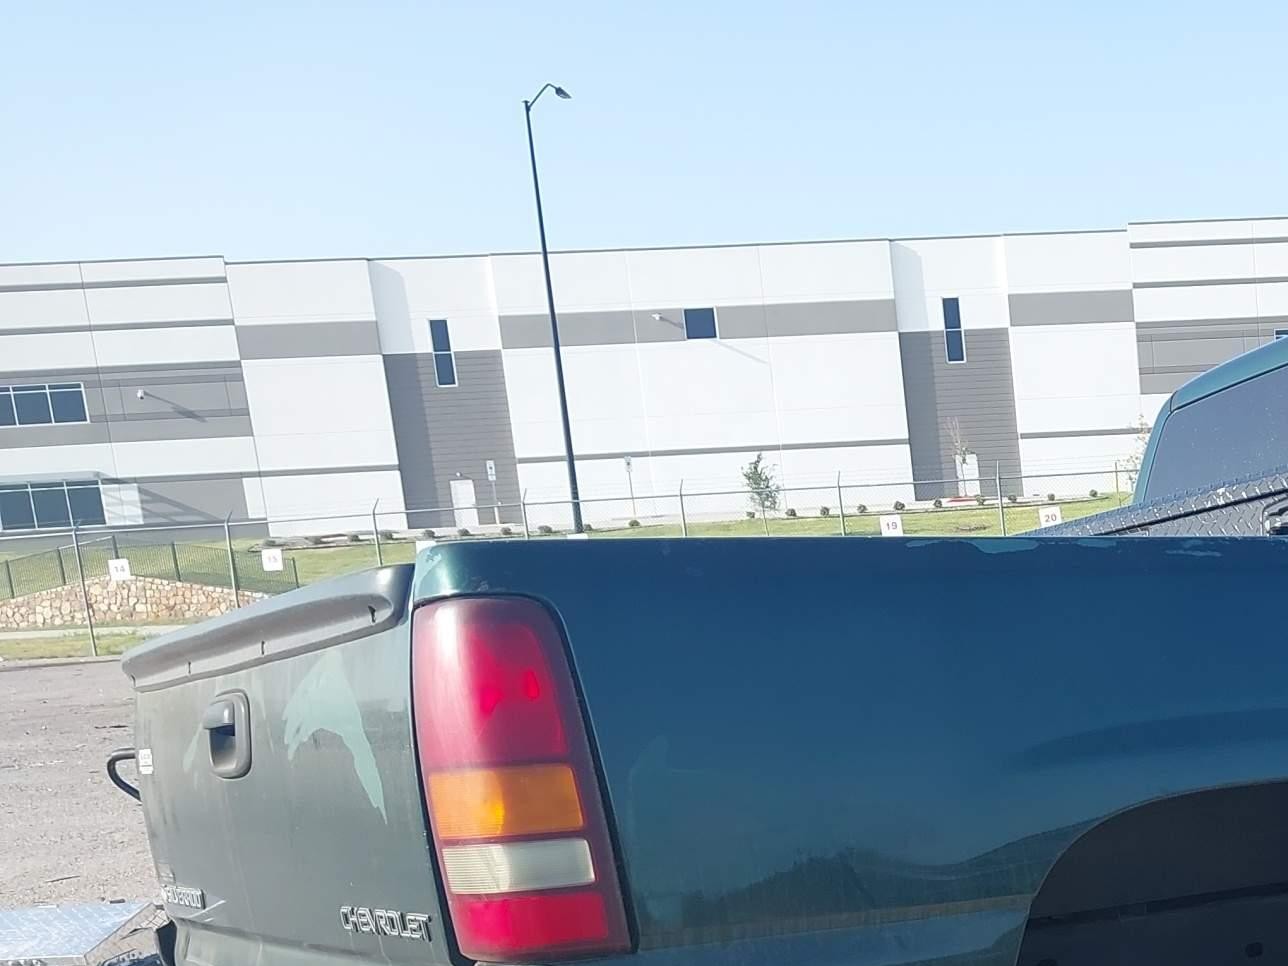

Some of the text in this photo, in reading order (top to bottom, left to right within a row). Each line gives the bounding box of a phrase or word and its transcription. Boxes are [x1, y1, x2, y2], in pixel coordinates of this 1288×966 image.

[1044, 513, 1057, 523] 20
[886, 521, 898, 531] 19
[340, 906, 432, 941] CHEVROLET
